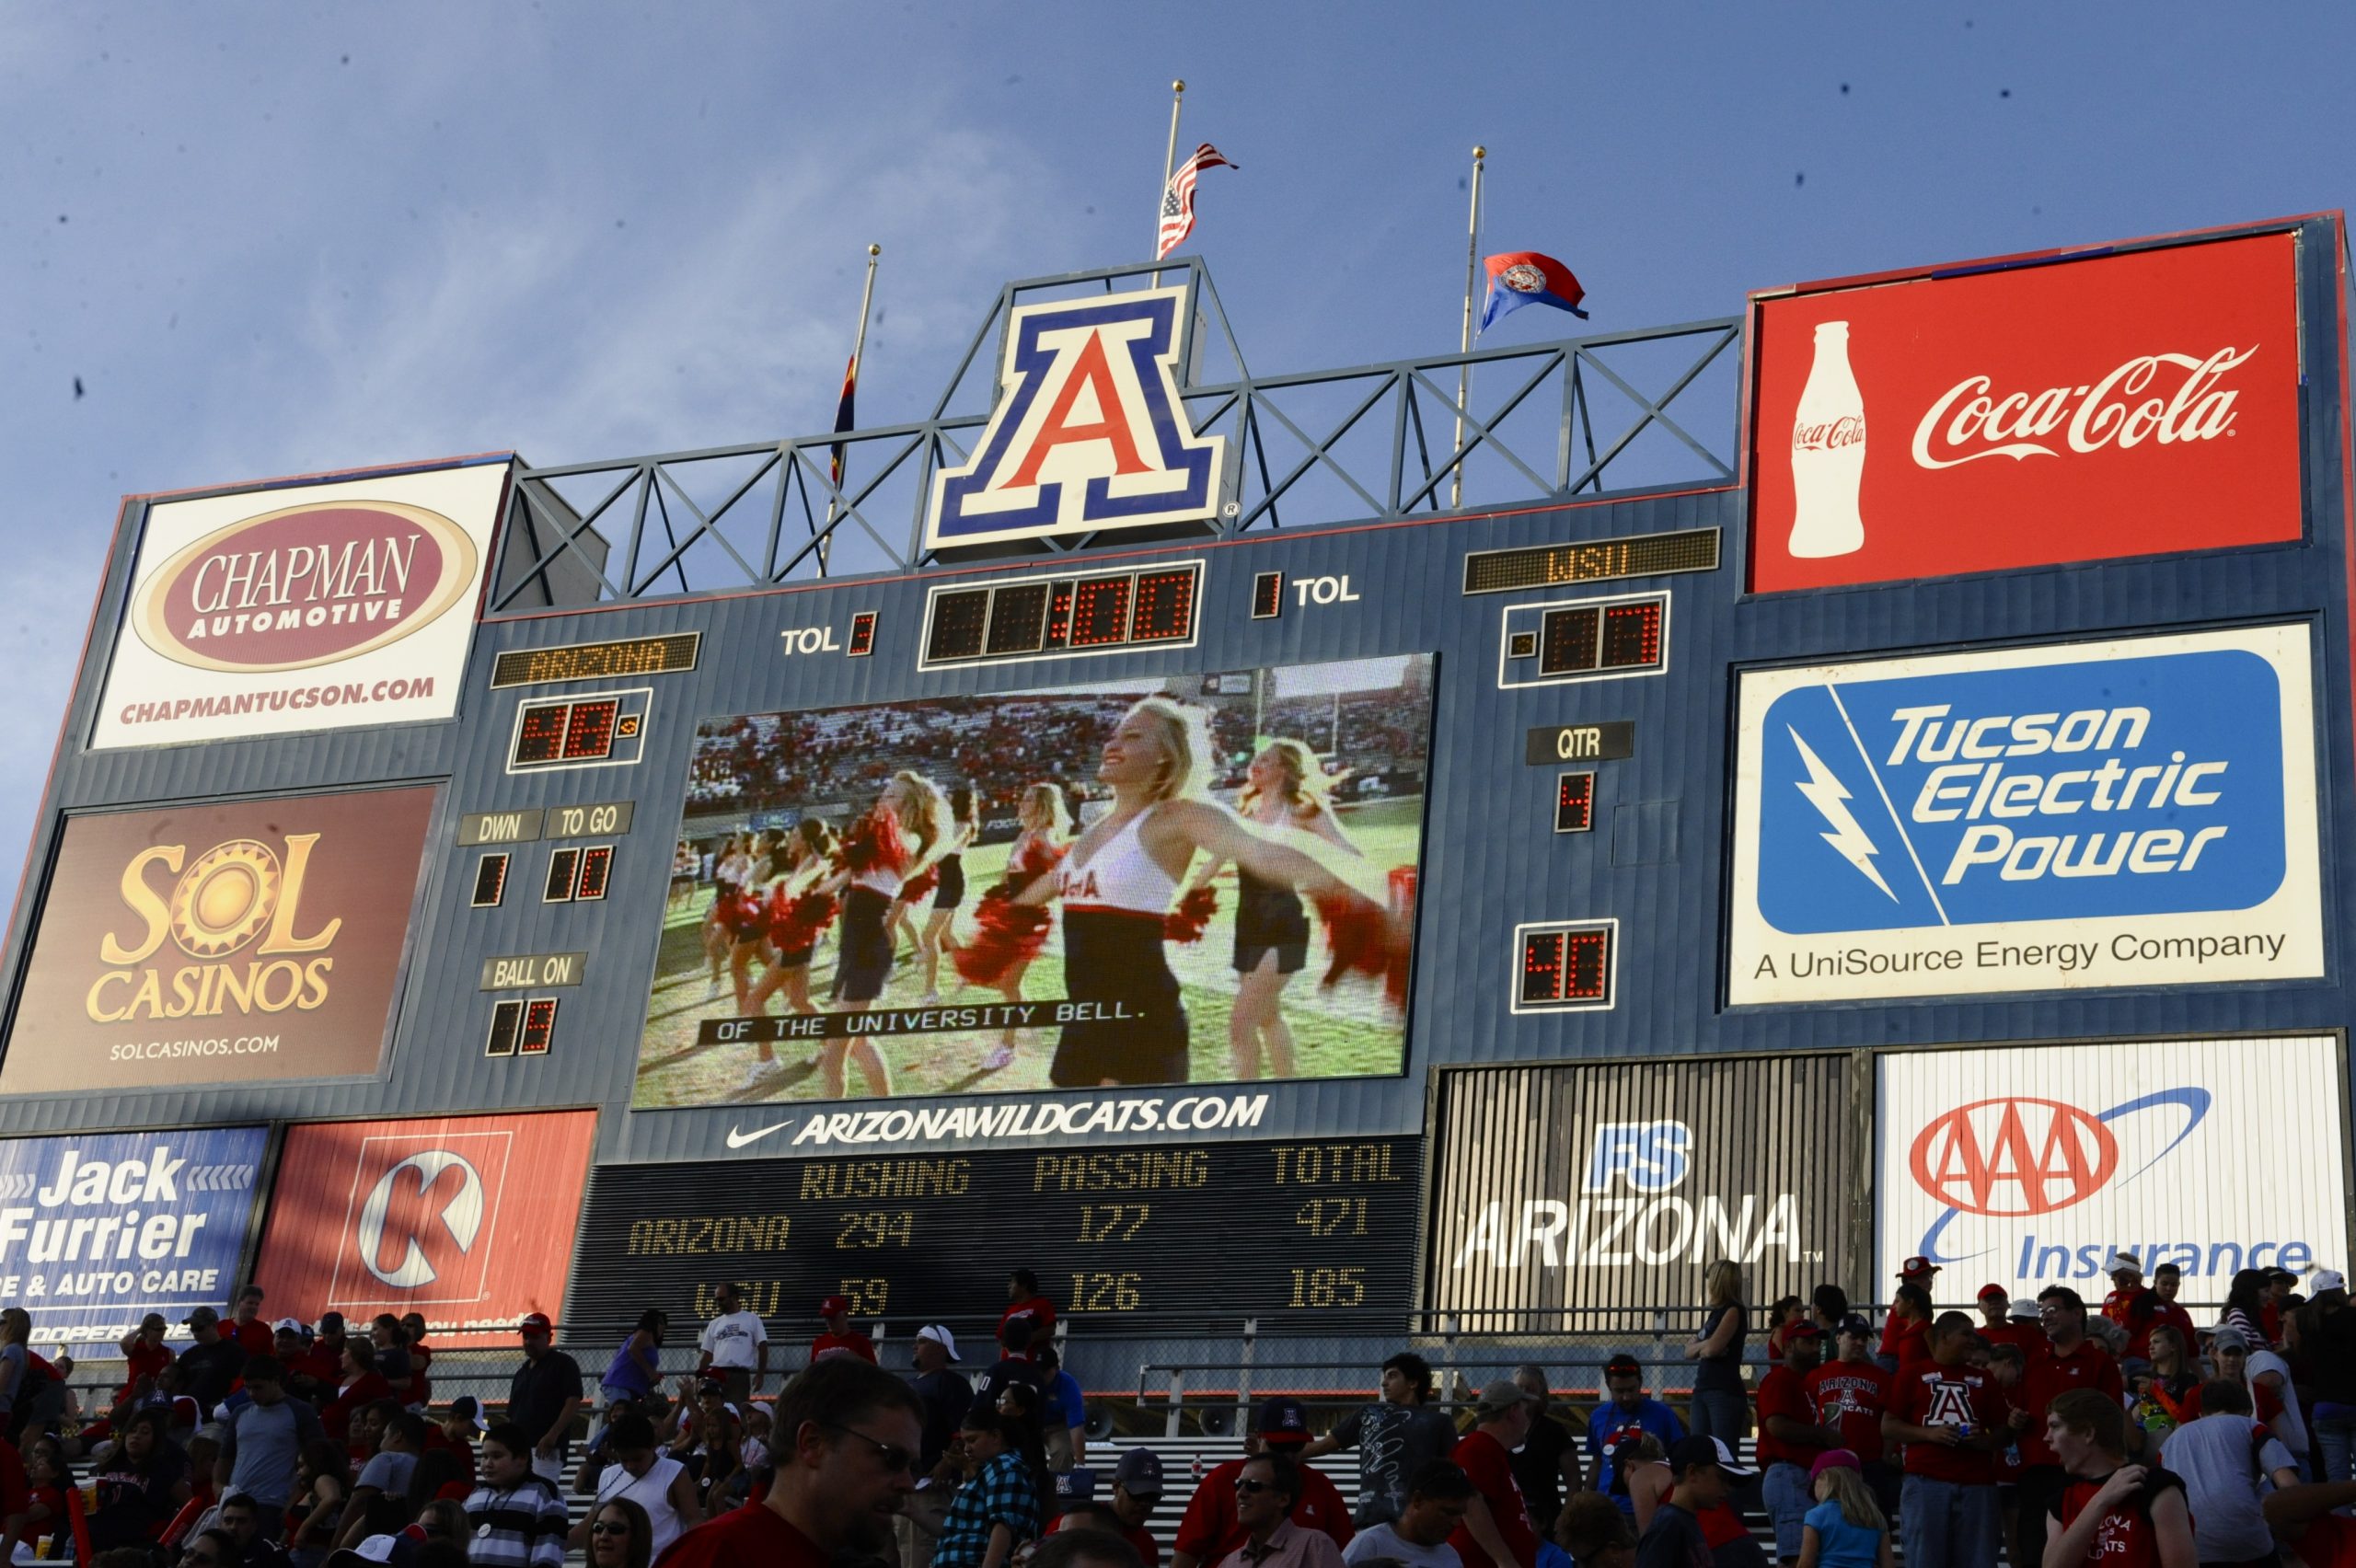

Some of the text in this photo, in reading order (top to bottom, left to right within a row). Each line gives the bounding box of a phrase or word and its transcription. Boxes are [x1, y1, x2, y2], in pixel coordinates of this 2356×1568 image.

[930, 290, 1222, 545] A
[1911, 343, 2259, 469] Coca-Cola
[1794, 415, 1864, 451] Coca-Cola
[191, 535, 422, 614] CHAPMAN
[1547, 545, 1628, 582] WSU
[1292, 575, 1360, 606] TOL
[187, 599, 402, 640] AUTOMOTIVE
[780, 627, 840, 655] TOL
[526, 642, 666, 682] ARIZONA
[121, 677, 434, 724] CHAPMANTUCSON.COM
[1557, 728, 1601, 759] QTR
[1886, 704, 2151, 766] Tucson
[1911, 751, 2228, 823] Electric
[479, 814, 522, 841] DWN
[562, 806, 617, 835] TO GO
[1942, 824, 2228, 885] Power
[100, 833, 342, 964] SOL
[493, 957, 572, 986] BALL ON
[1754, 931, 2287, 980] A UniSource Energy Company
[87, 958, 333, 1022] CASINOS
[717, 1001, 1146, 1042] OF THE UNIVERSITY BELL.
[110, 1035, 280, 1060] SOLCASINOS.COM
[791, 1094, 1269, 1146] ARIZONAWILDCATS.COM
[38, 1147, 186, 1207] Jack
[800, 1144, 1401, 1199] RUSHING PASSING TOTAL
[1581, 1119, 1693, 1194] FS
[1928, 1100, 2098, 1214] AAA
[0, 1207, 207, 1263] Furrier
[628, 1198, 1368, 1254] ARIZONA 294 177 471
[1452, 1193, 1801, 1269] ARIZONA
[26, 1274, 47, 1297] &
[55, 1271, 134, 1296] AUTO
[142, 1269, 219, 1292] CARE
[838, 1279, 890, 1315] 59
[1068, 1273, 1142, 1311] 126
[1288, 1268, 1366, 1308] 185
[1819, 1377, 1878, 1398] ARIZONA
